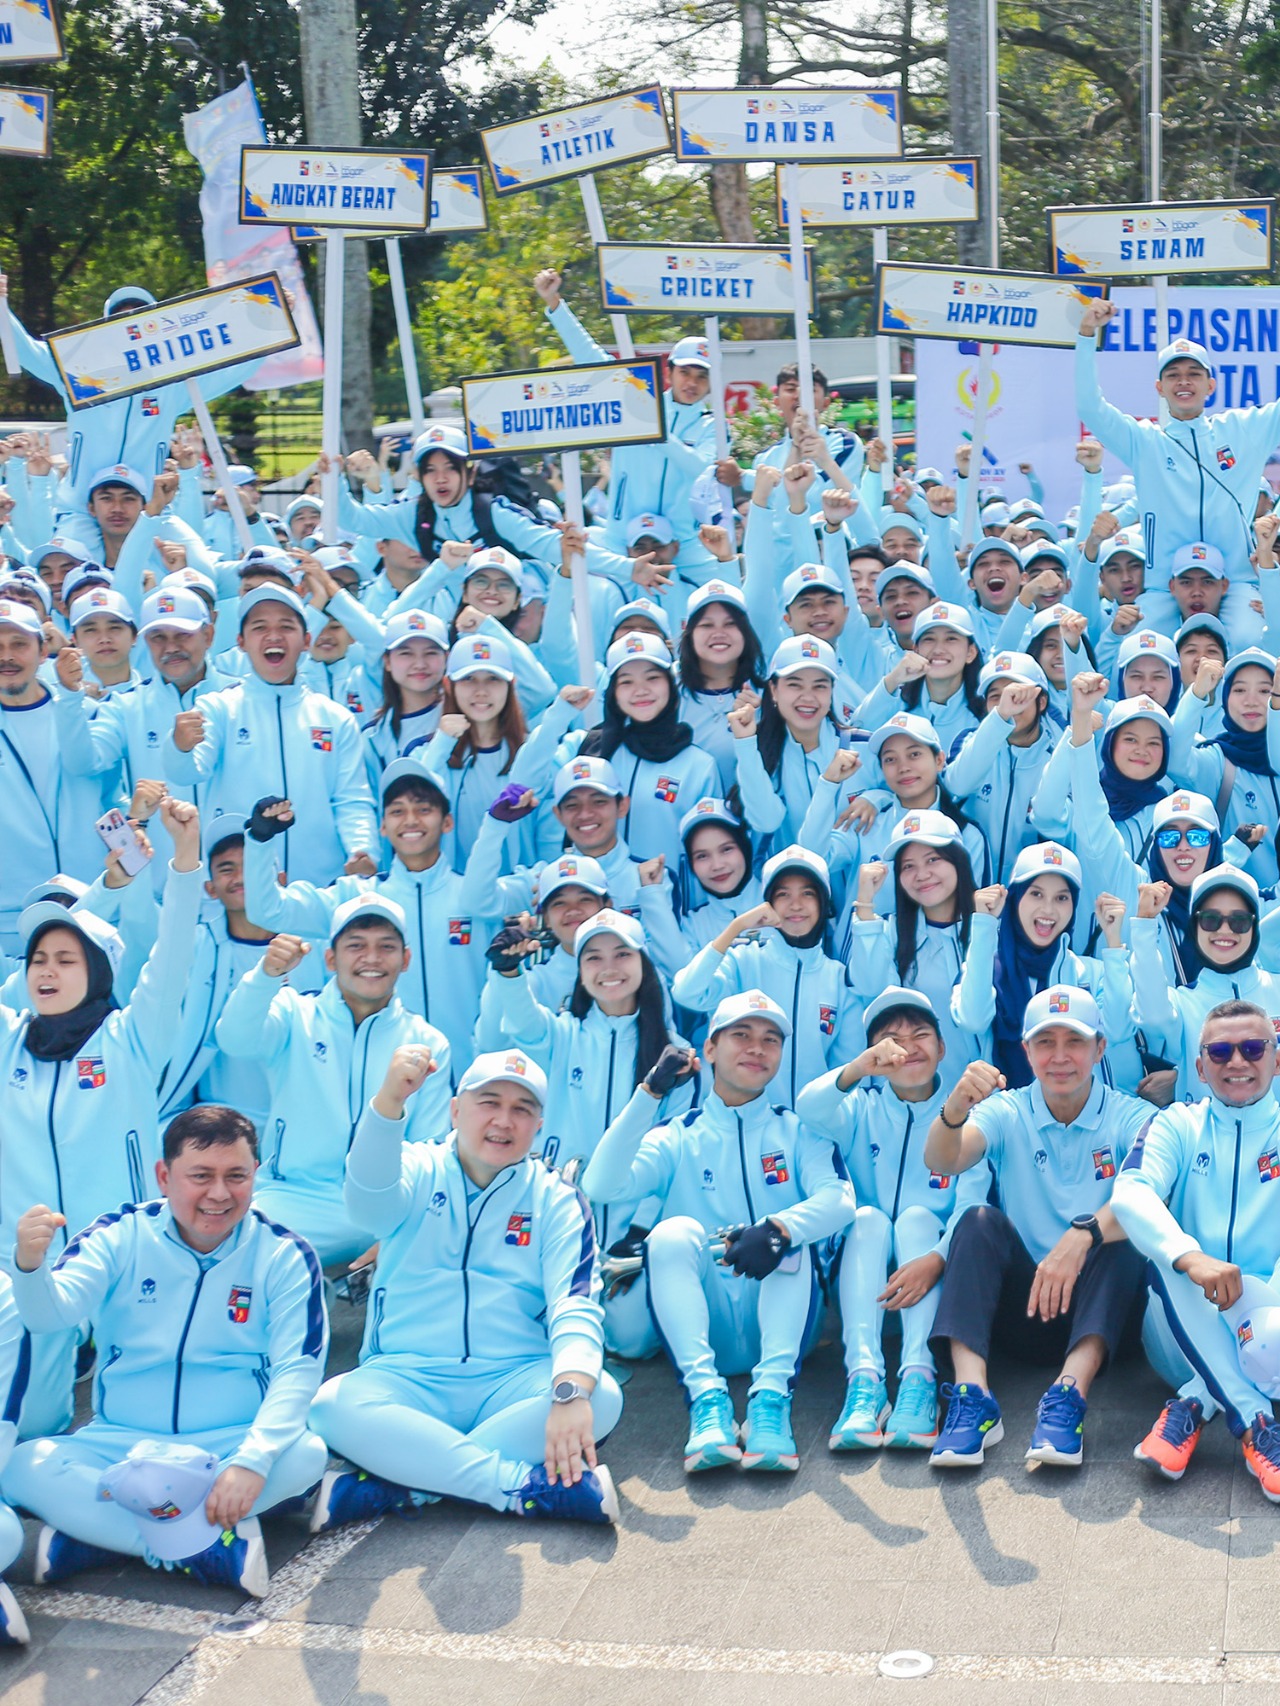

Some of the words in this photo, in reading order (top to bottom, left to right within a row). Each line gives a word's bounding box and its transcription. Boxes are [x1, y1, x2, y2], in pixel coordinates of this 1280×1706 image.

[745, 121, 836, 143] DANSA
[540, 127, 616, 166] ATLETIK
[270, 183, 337, 208] ANGKAT
[341, 185, 397, 210] BERAT
[843, 189, 916, 211] CATUR
[1120, 237, 1206, 261] SENAM
[660, 276, 755, 299] CRICKET
[946, 301, 1038, 328] HAPKIDO
[1104, 308, 1279, 353] ELEPASAN
[123, 323, 235, 374] BRIDGE
[1203, 364, 1261, 408] OTA
[501, 400, 622, 433] BULUTANGKIS
